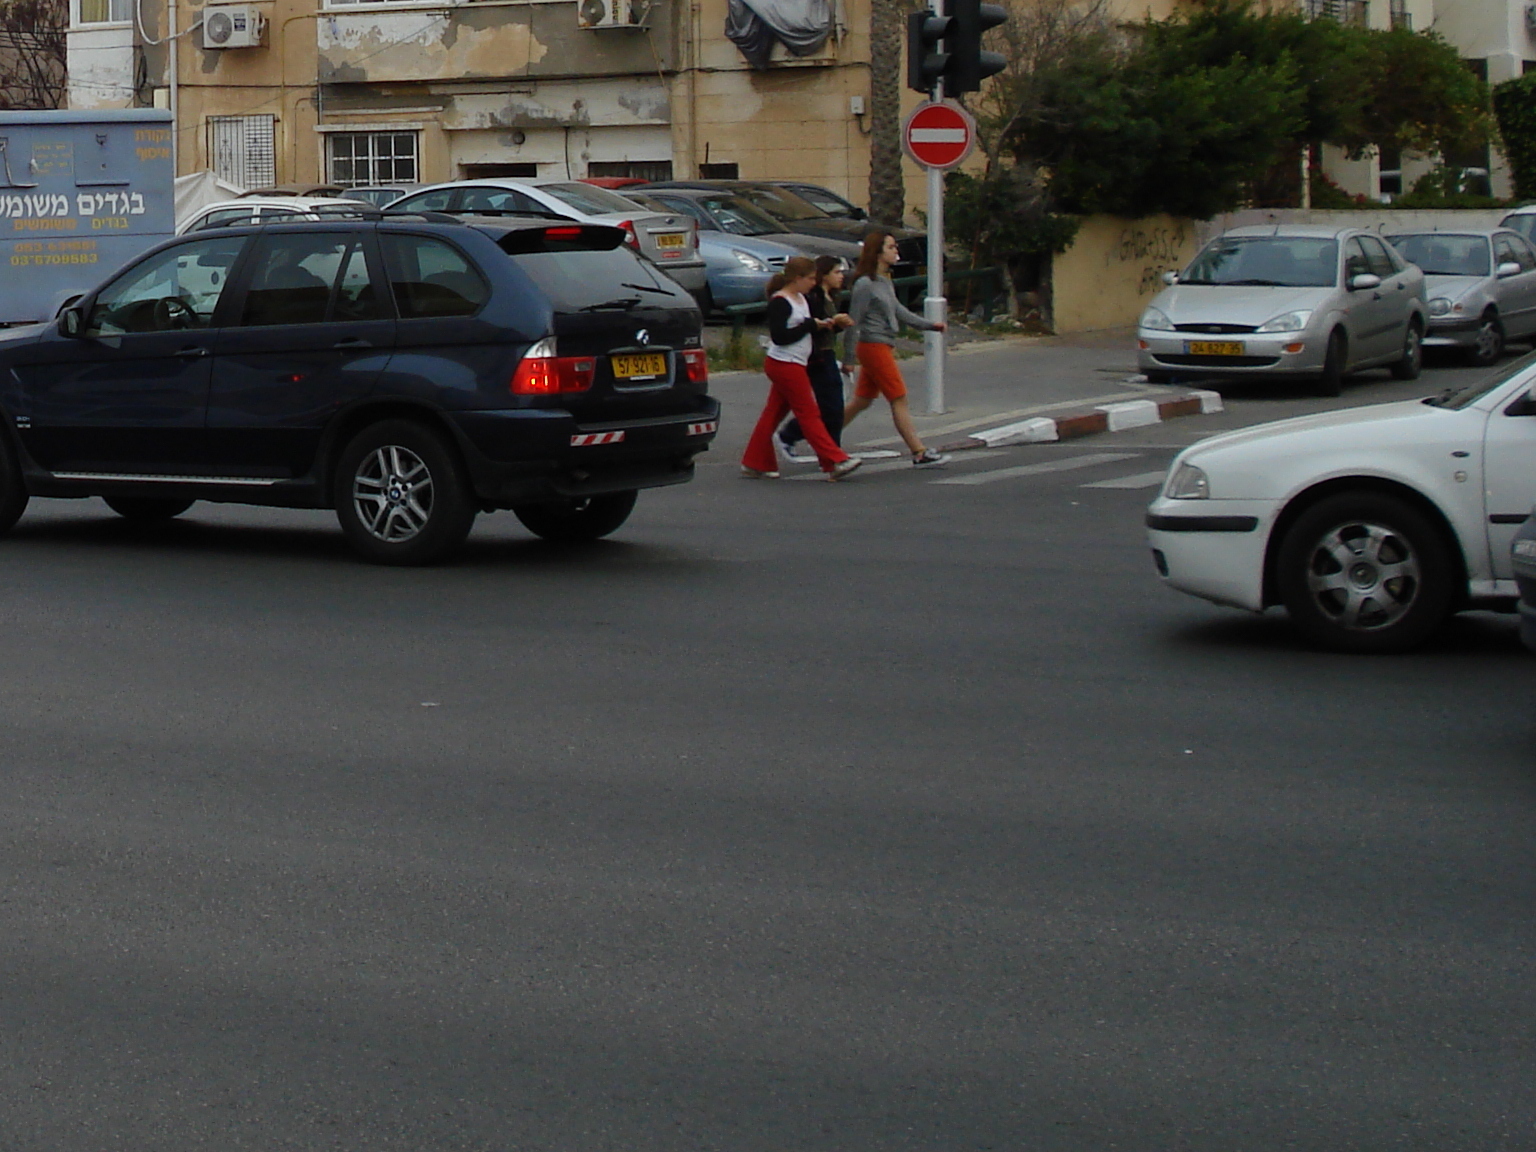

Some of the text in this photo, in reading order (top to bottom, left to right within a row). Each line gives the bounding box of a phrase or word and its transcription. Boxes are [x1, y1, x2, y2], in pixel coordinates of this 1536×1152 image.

[76, 190, 146, 216] בגדים
[13, 217, 129, 230] בגדים משומשים
